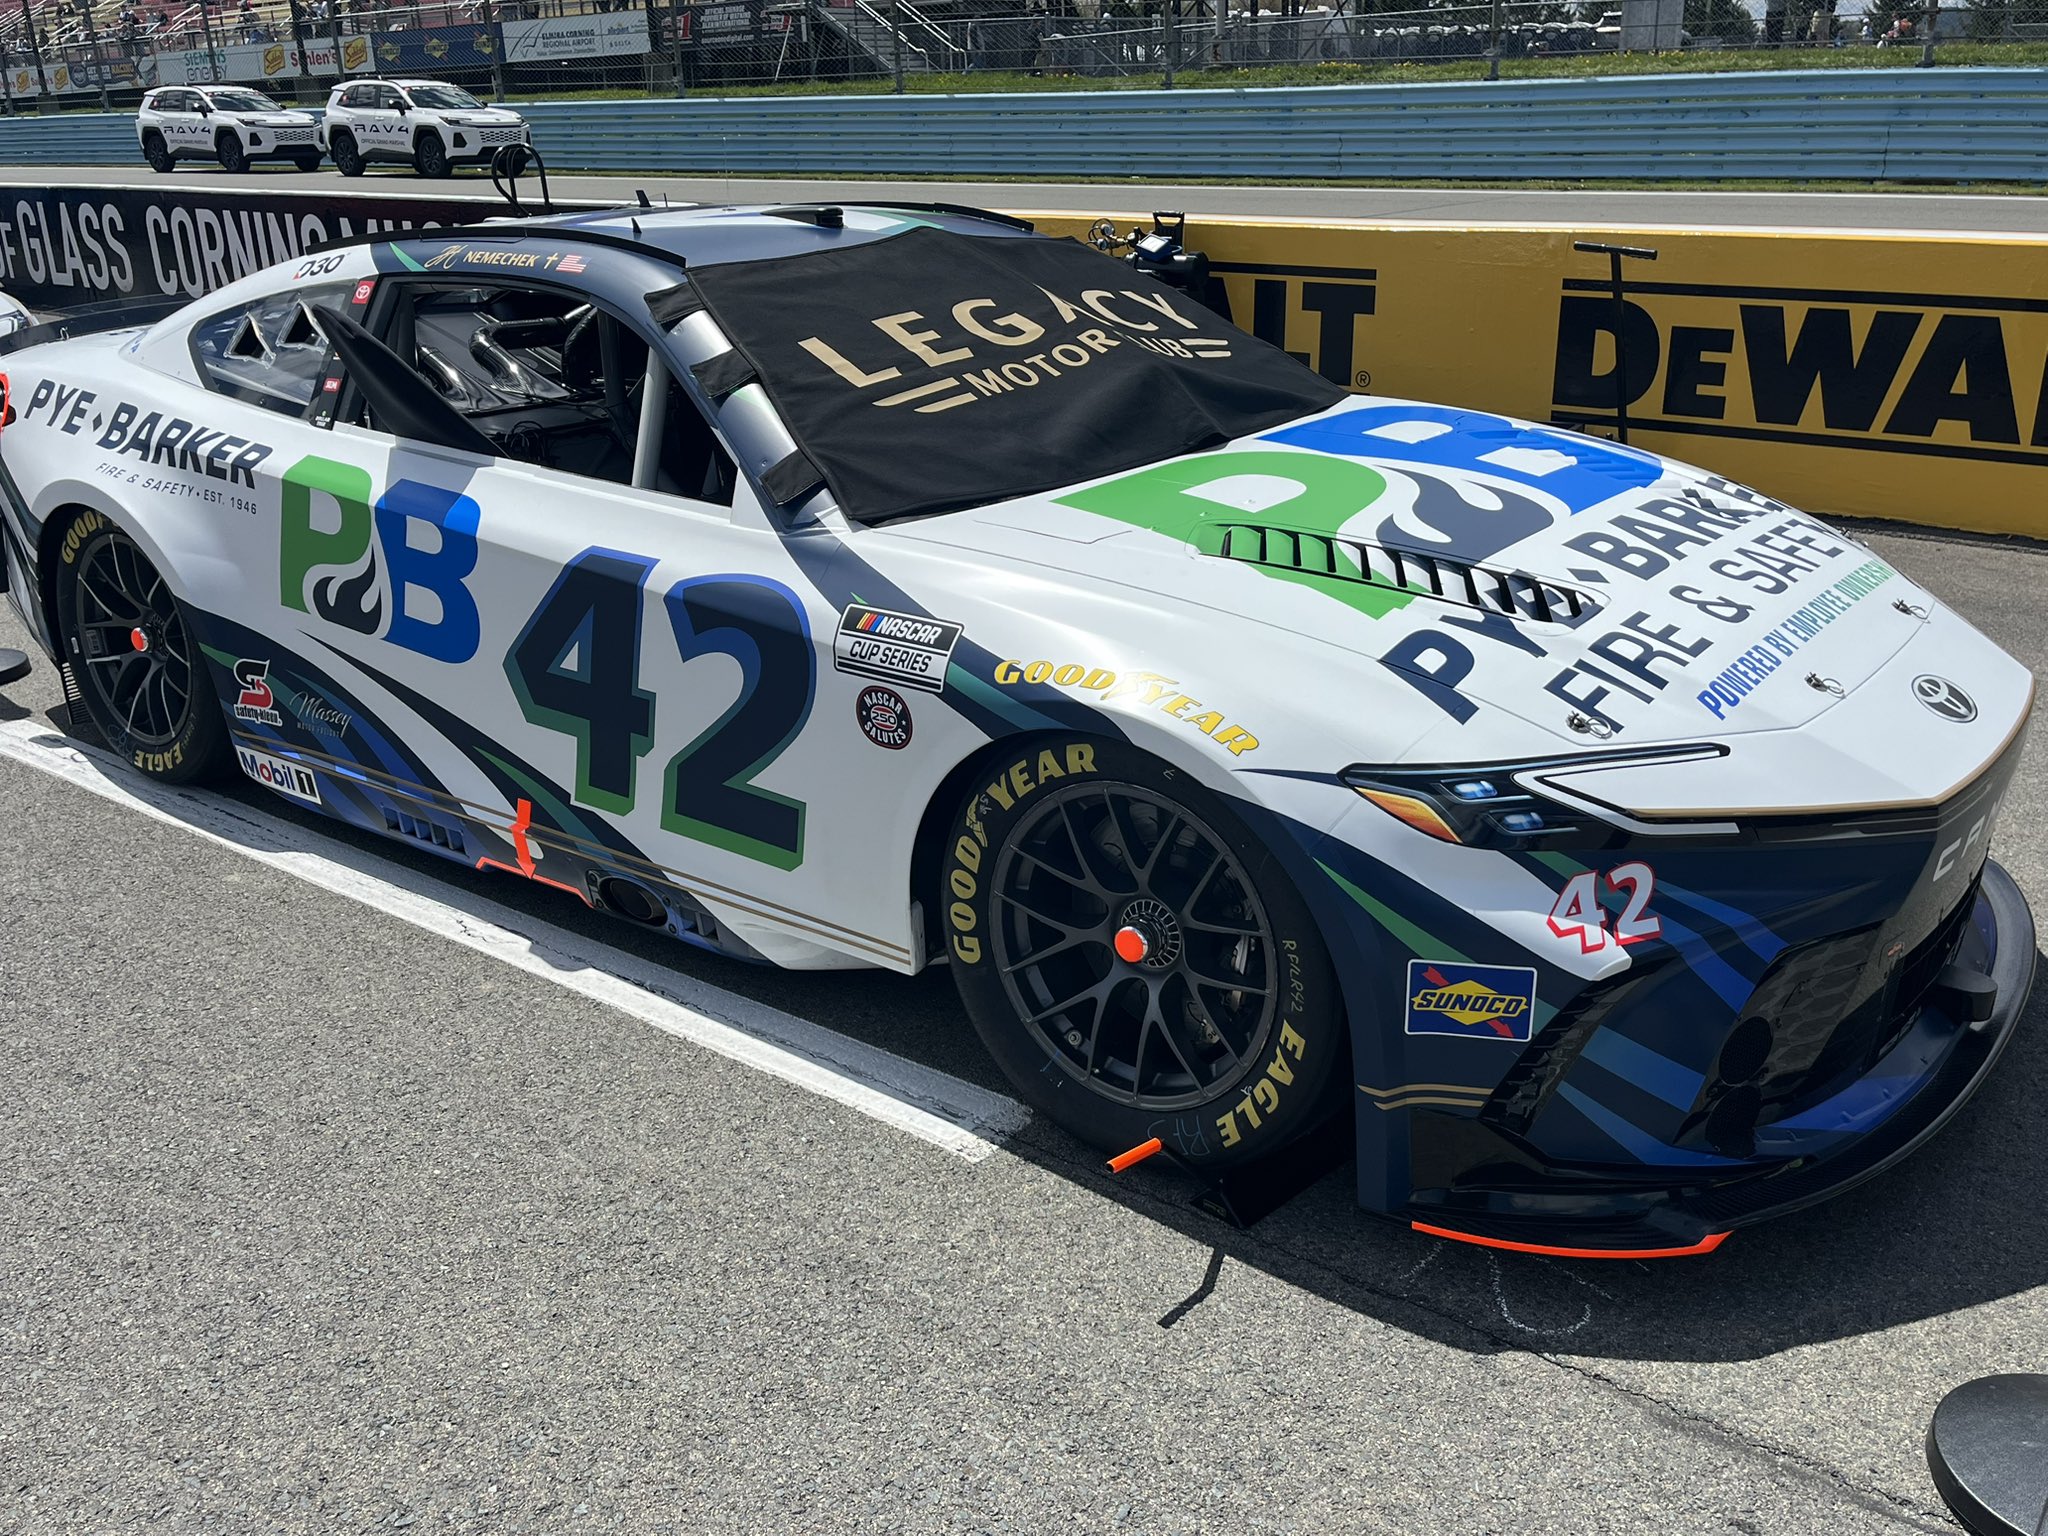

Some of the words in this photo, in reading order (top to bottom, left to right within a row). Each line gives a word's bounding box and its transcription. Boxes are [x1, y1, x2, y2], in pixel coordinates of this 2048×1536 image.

[543, 39, 571, 49] REGIONAL
[572, 37, 596, 47] AIRPORT
[566, 29, 595, 38] CORNING
[184, 49, 226, 67] SIEMNS
[290, 49, 337, 68] Shlen's
[163, 126, 211, 135] RAV4
[354, 123, 409, 135] RAV4
[16, 200, 134, 293] GLASS
[463, 250, 540, 268] NEMECHEK
[797, 284, 1198, 388] LEGACY
[961, 327, 1122, 398] MOTOR
[24, 378, 97, 436] PYE
[96, 402, 274, 490] BARKER
[96, 462, 127, 479] FIRE
[129, 474, 139, 484] &
[142, 477, 194, 498] SAFETY
[203, 489, 225, 506] EST.
[230, 496, 258, 515] 1946
[280, 454, 480, 663] PB
[876, 615, 942, 645] NASCAR
[1780, 589, 1852, 643] EMPLOYEE
[850, 641, 880, 661] CUP
[879, 646, 932, 673] SERIES
[1543, 611, 1714, 735] FIRE
[1669, 585, 1756, 624] &
[1762, 629, 1800, 657] BY
[864, 692, 903, 714] NASCAR
[1696, 644, 1783, 721] POWERED
[290, 691, 352, 738] Massey
[502, 546, 817, 872] 42
[872, 711, 897, 725] 250
[994, 659, 1260, 757] GOODYEAR
[864, 721, 907, 745] SALUTES
[134, 742, 183, 772] EAGLE
[239, 750, 296, 791] Mobil
[950, 743, 1098, 964] GOODYEAR
[1547, 861, 1663, 955] 42
[1417, 991, 1524, 1015] SUNOCO
[1215, 1019, 1306, 1148] EAGLE
